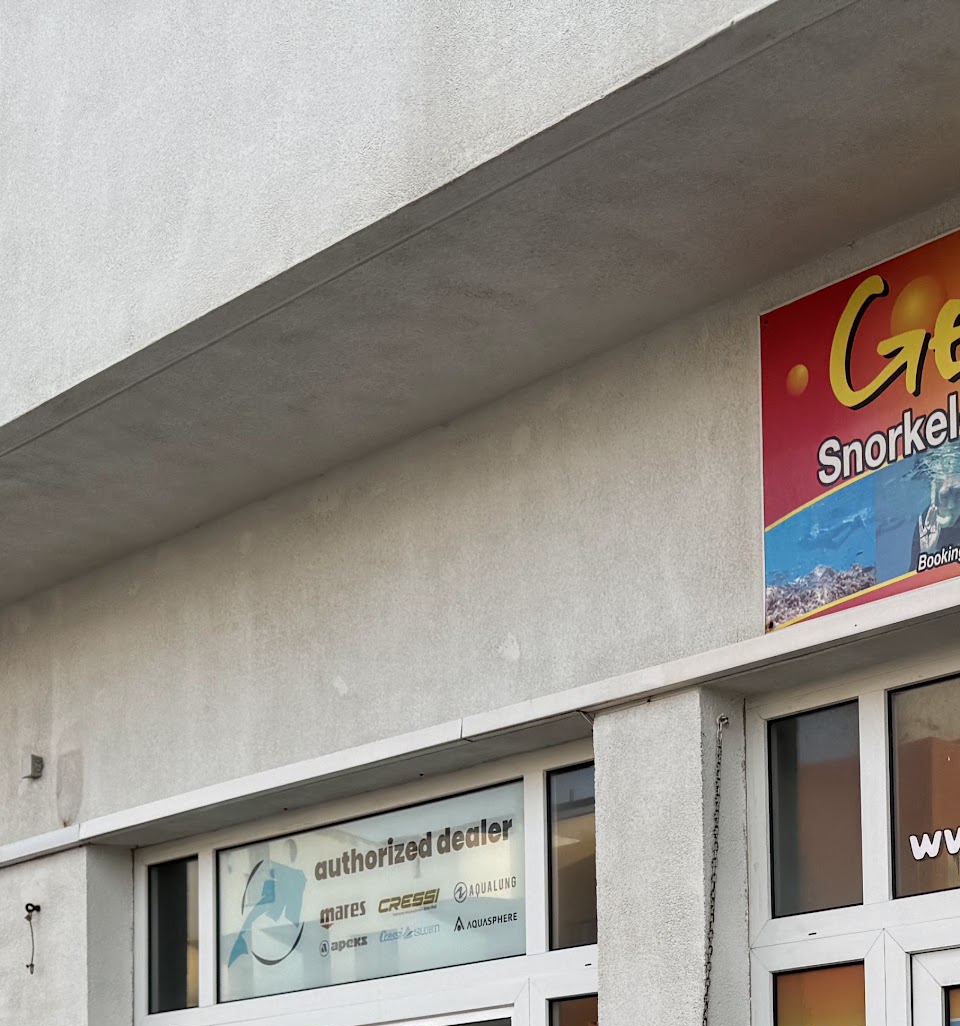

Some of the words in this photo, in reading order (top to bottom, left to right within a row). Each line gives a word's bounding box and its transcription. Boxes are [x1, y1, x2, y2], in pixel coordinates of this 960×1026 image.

[315, 831, 432, 881] authorized
[436, 818, 513, 853] dealer
[468, 876, 517, 897] AQUALUNG
[320, 899, 367, 925] mares
[378, 888, 440, 913] CRESSI
[466, 912, 518, 930] AQUASPHERE
[330, 935, 368, 952] apeks
